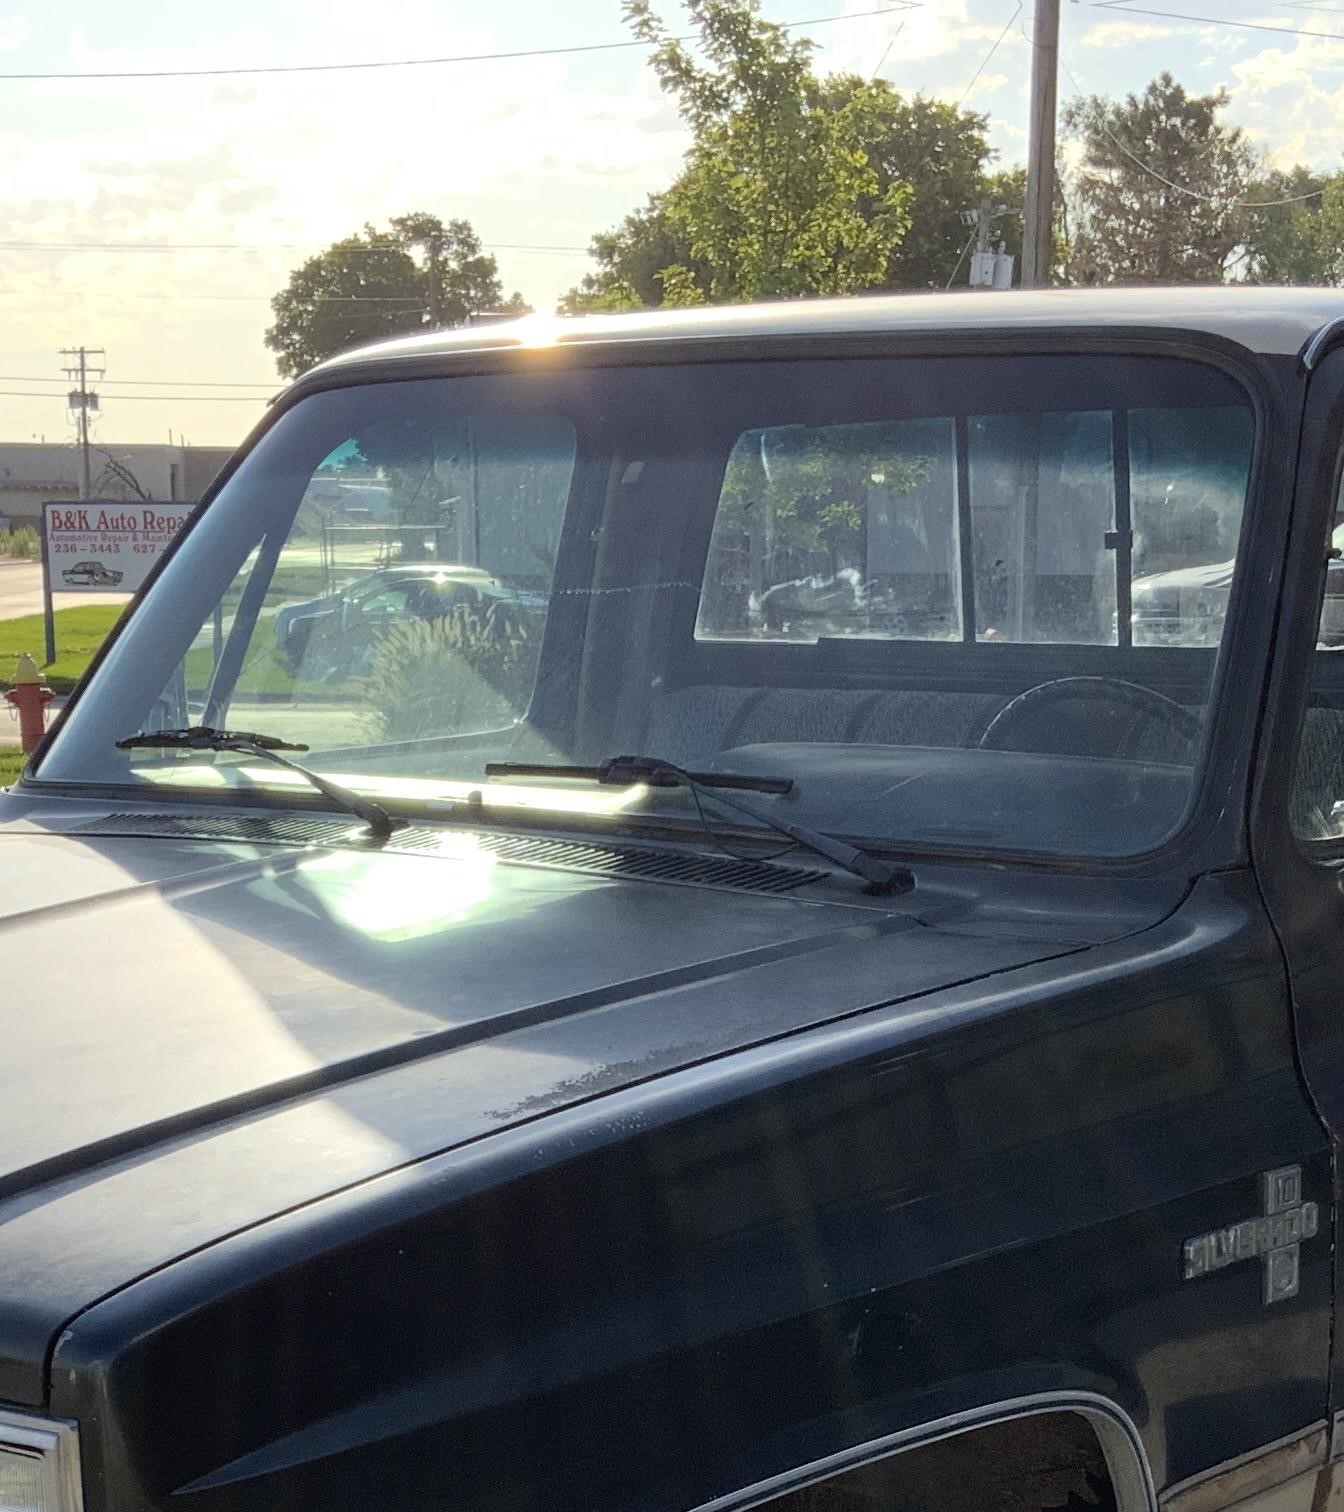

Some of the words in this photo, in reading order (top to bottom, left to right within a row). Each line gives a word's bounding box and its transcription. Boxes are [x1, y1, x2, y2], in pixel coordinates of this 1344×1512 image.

[50, 510, 90, 530] B&K
[97, 510, 137, 530] Auto
[142, 510, 190, 535] Repa
